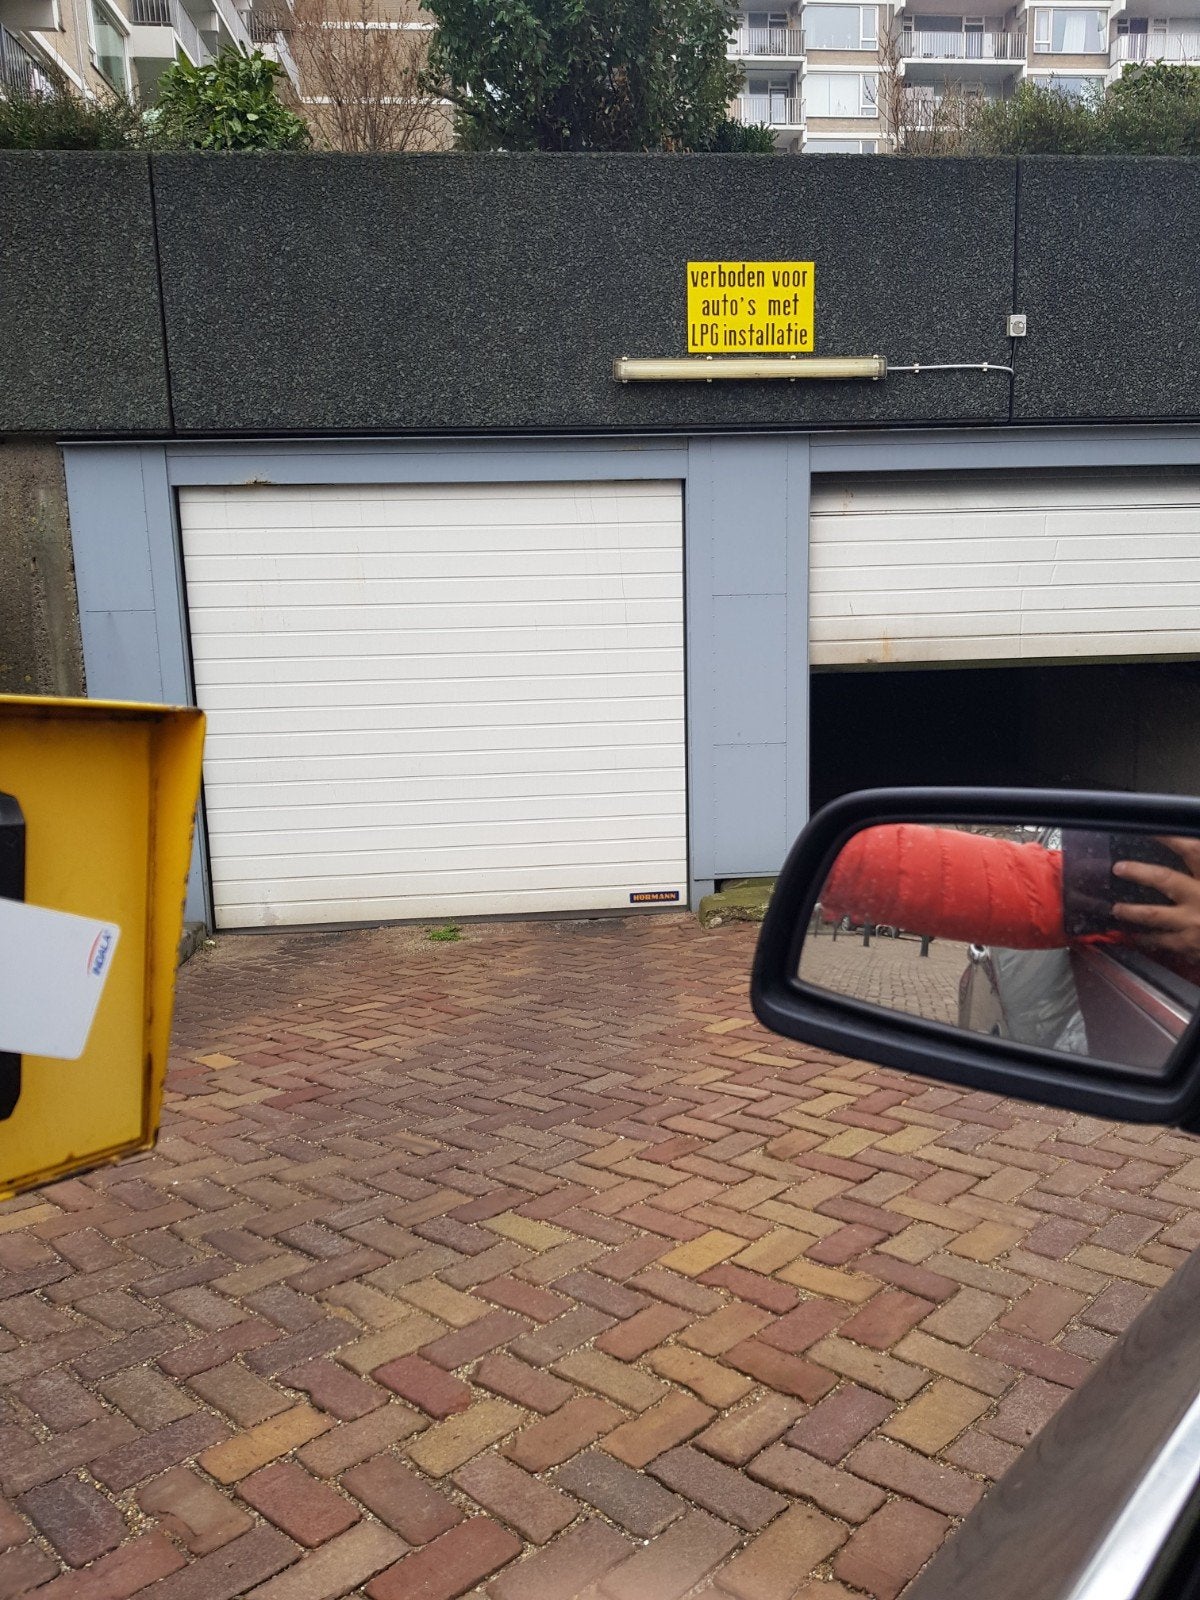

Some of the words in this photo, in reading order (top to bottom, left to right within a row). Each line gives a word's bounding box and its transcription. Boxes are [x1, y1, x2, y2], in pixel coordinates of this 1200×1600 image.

[690, 264, 765, 288] verboden
[772, 270, 808, 288] voor
[702, 293, 756, 316] auto's
[768, 293, 799, 316] met
[691, 323, 719, 347] LPG
[723, 322, 808, 346] installatie
